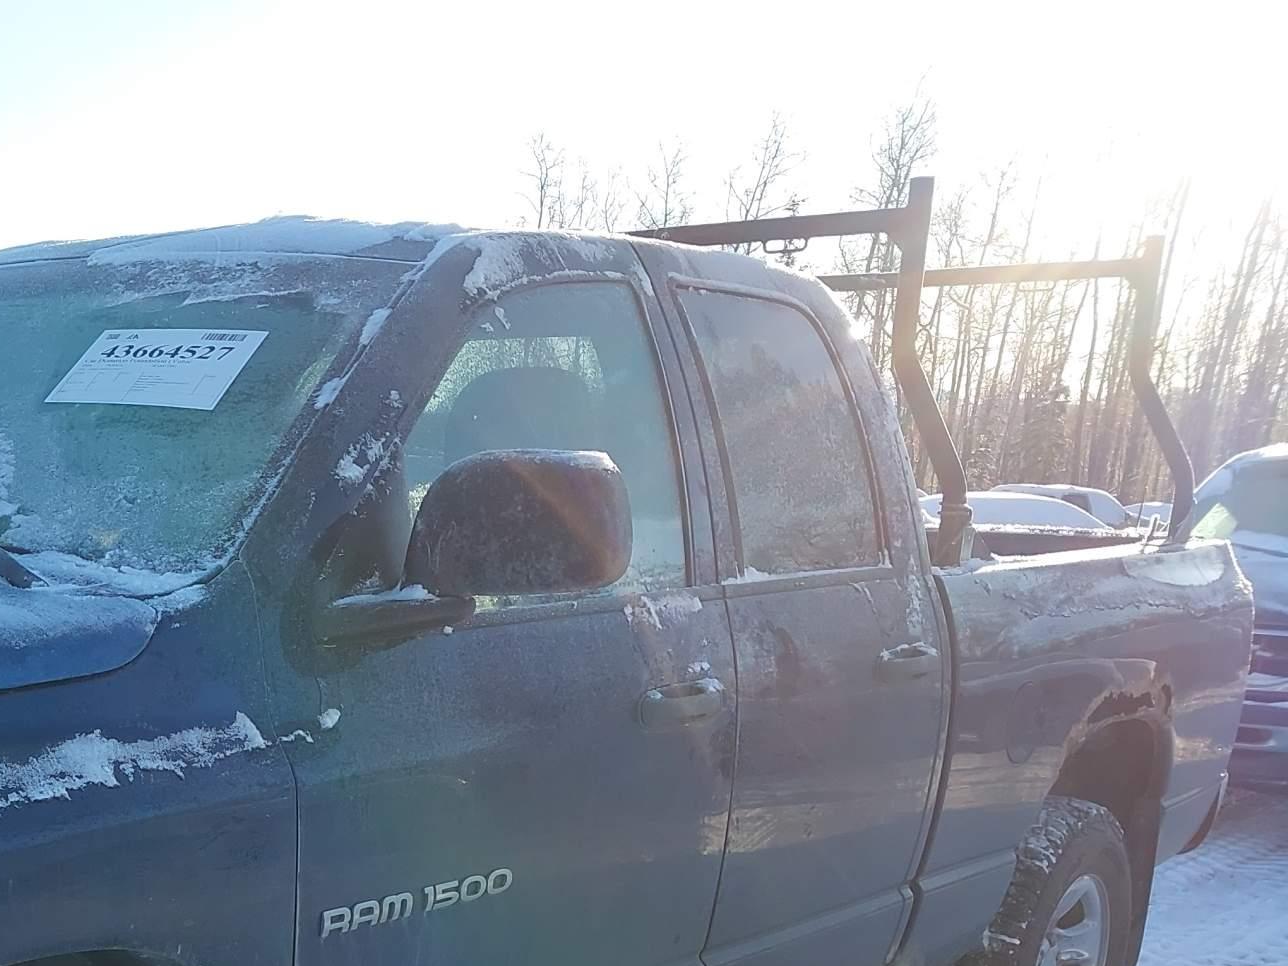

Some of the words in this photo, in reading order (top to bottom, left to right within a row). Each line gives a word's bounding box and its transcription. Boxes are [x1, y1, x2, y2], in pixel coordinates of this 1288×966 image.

[100, 344, 236, 361] 43664527
[321, 892, 414, 939] RAM
[423, 867, 514, 912] 1500
